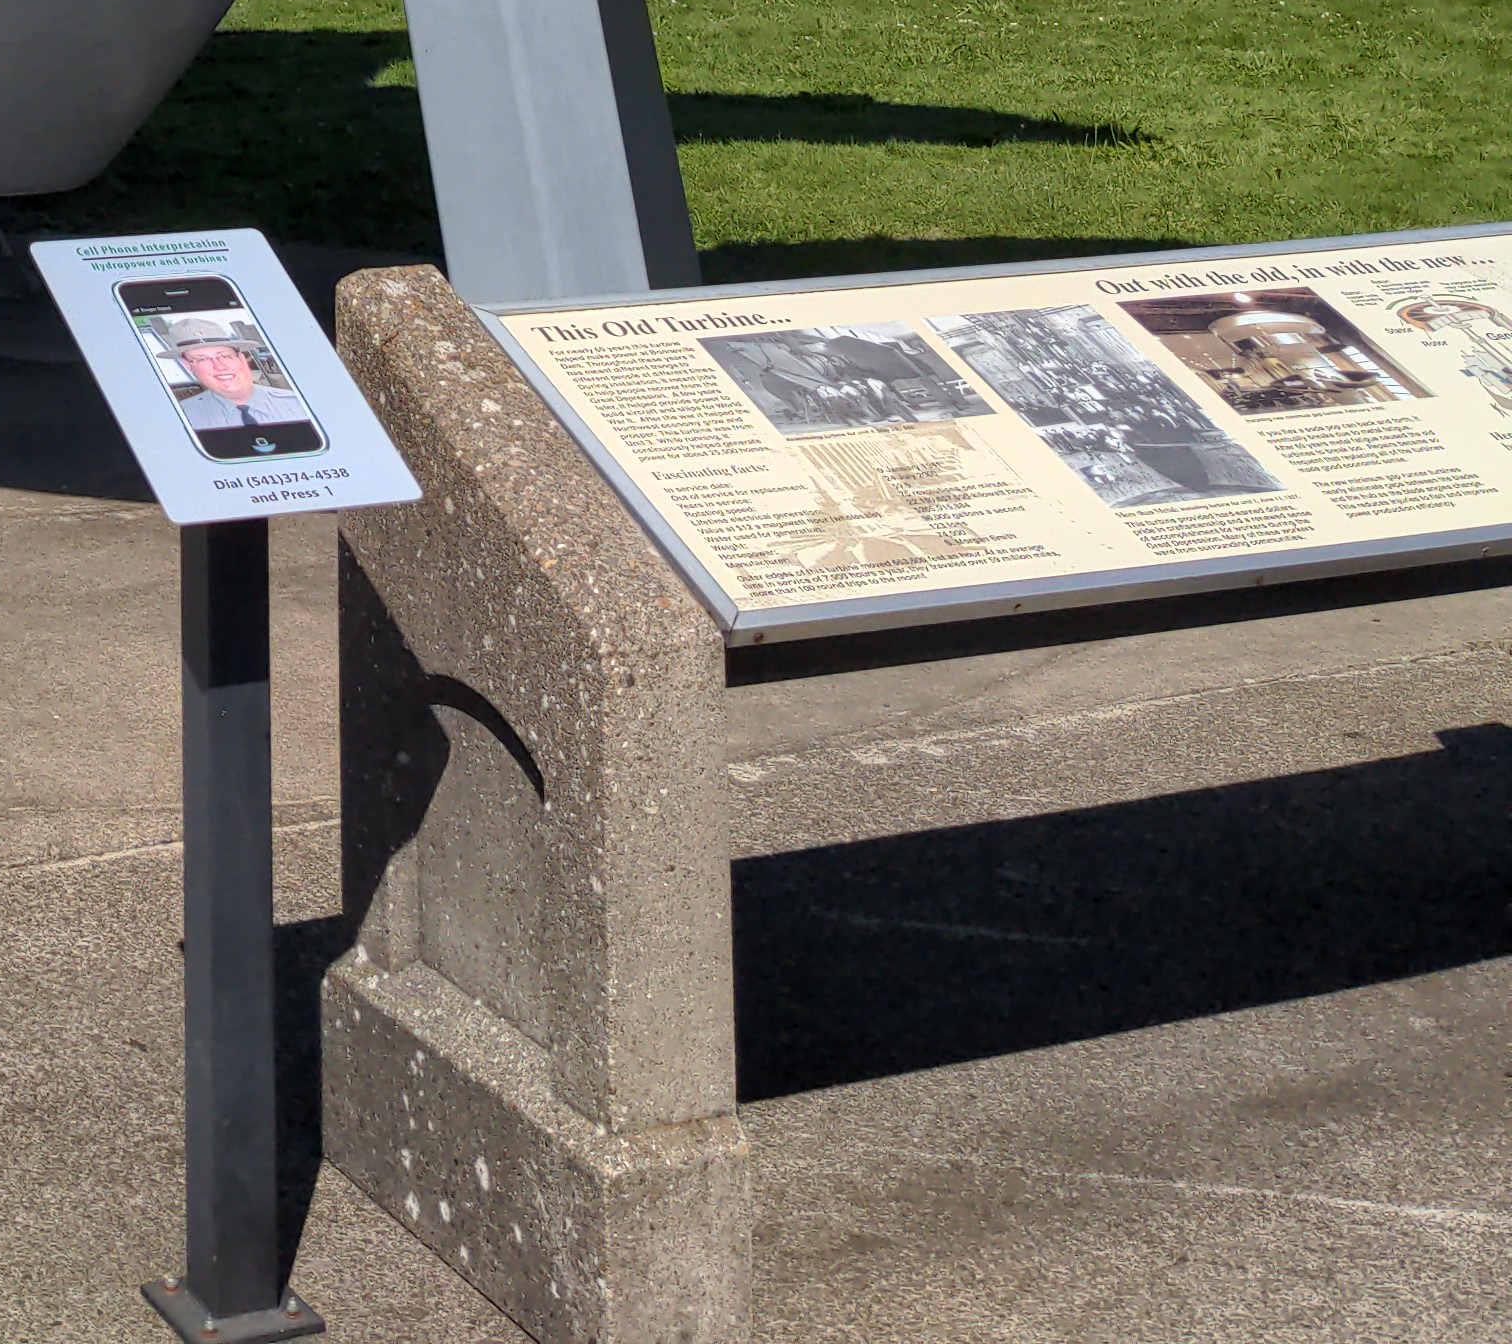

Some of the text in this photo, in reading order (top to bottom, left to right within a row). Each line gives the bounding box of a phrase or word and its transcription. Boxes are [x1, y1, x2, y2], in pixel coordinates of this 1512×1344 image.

[76, 239, 227, 256] Cell Phone Interpretation
[90, 254, 228, 272] Hydropower and Turbines
[1095, 279, 1149, 294] Out
[1149, 274, 1208, 290] with
[1206, 271, 1248, 286] the
[1250, 267, 1299, 283] old,
[1297, 264, 1326, 279] in
[1325, 260, 1380, 276] with
[1379, 258, 1420, 272] the
[530, 324, 599, 343] This
[601, 319, 658, 338] Old
[566, 347, 594, 355] nearly
[649, 347, 695, 355] Bonneville
[584, 367, 613, 375] meant
[613, 364, 650, 372] different
[585, 358, 638, 368] Throughout
[213, 468, 350, 490] Dial (541)374-4538
[651, 464, 769, 481] Fascinating facts:
[250, 486, 334, 504] and Press 1
[670, 494, 689, 502] Out
[701, 491, 735, 499] service
[675, 485, 709, 493] service
[683, 509, 725, 518] Rotating
[690, 518, 729, 526] Lifetime
[730, 513, 772, 523] electrical
[951, 510, 985, 519] gallons
[992, 505, 1026, 514] second
[696, 527, 725, 535] Value
[762, 519, 807, 529] megawatt
[733, 532, 758, 540] used
[953, 537, 990, 546] Morgan
[989, 533, 1017, 541] Smith
[736, 574, 763, 582] Outer
[764, 571, 795, 580] edges
[805, 567, 825, 575] this
[824, 564, 860, 573] turbine
[858, 560, 892, 569] moved
[927, 554, 947, 562] feet
[1009, 544, 1045, 553] average
[776, 578, 812, 587] service
[929, 560, 967, 570] traveled
[1001, 554, 1033, 562] million
[749, 590, 775, 598] more
[774, 587, 797, 595] than
[797, 584, 816, 592] 100
[816, 581, 845, 590] round
